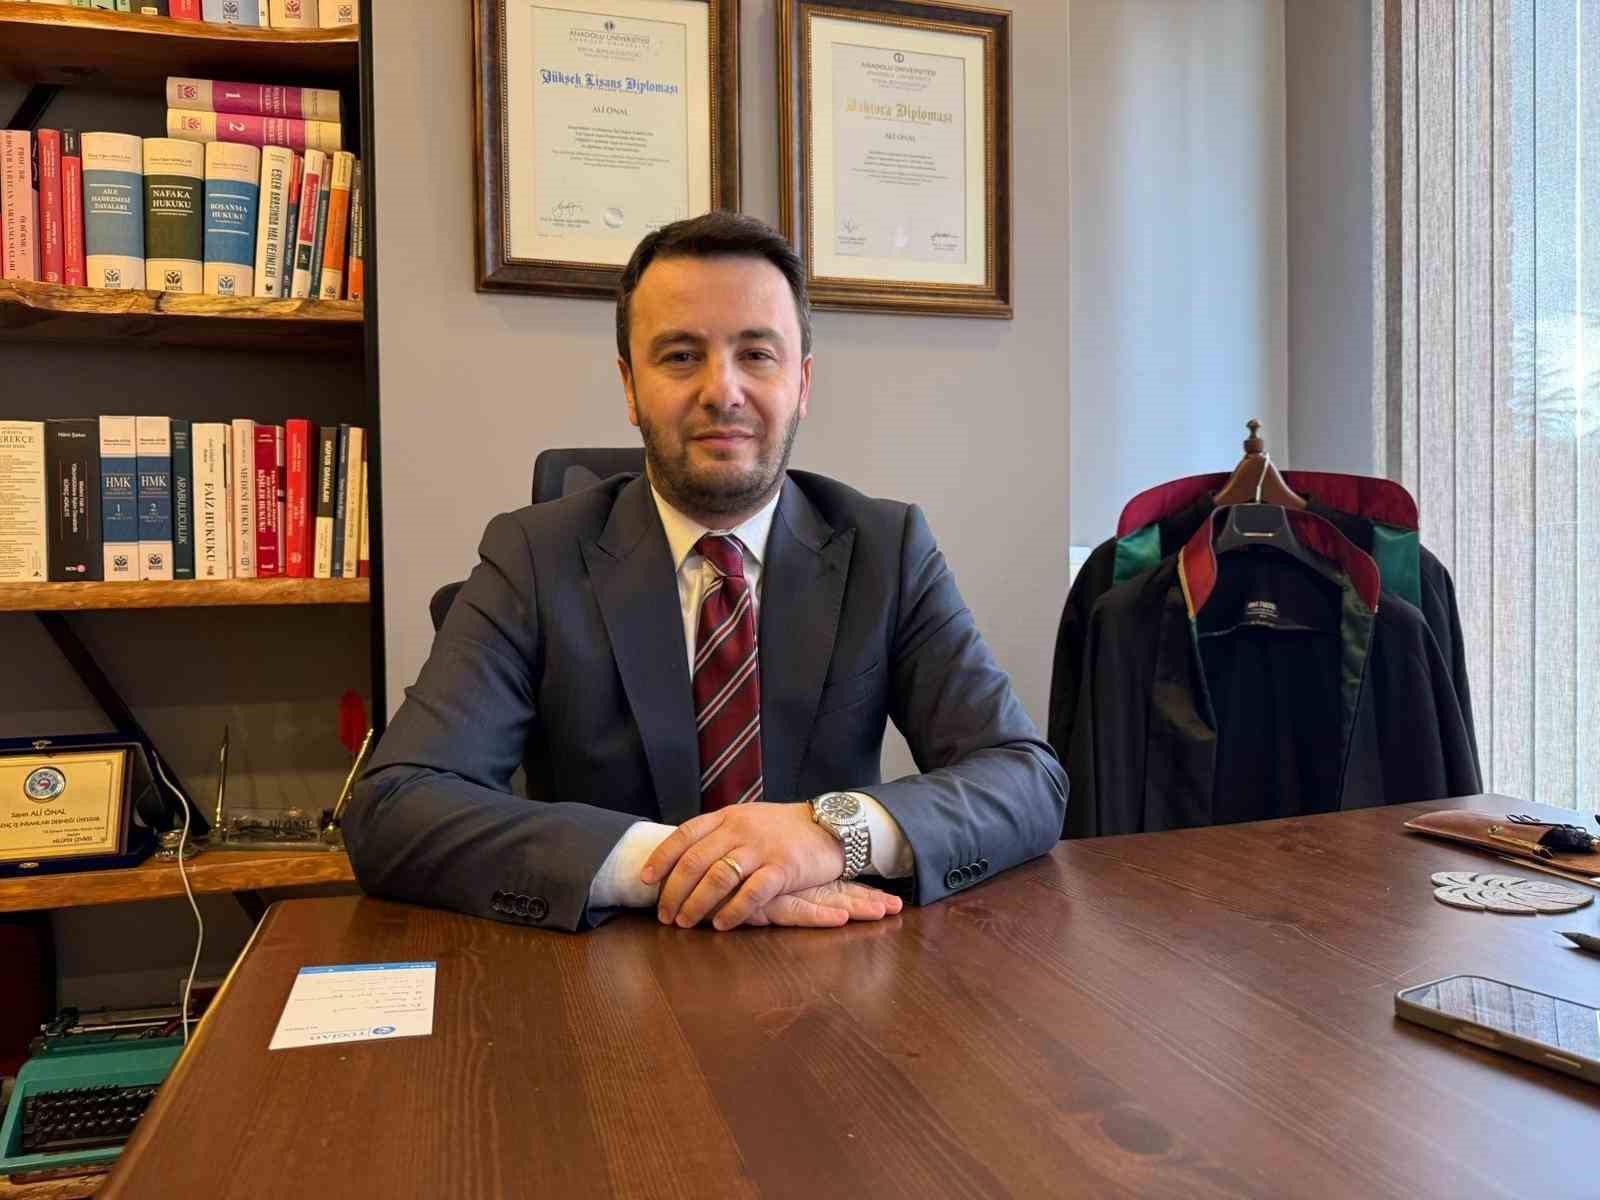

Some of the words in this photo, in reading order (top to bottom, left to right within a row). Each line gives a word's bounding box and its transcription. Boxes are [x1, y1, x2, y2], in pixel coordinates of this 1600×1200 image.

[584, 72, 623, 89] Lisans
[152, 189, 191, 199] NAFAKA
[152, 199, 192, 209] HUKUKU
[323, 440, 332, 466] NÜFUS
[105, 476, 132, 489] HMK
[141, 475, 169, 488] HMK
[322, 466, 331, 503] DAVALARI
[204, 482, 217, 510] FAİZ
[177, 475, 188, 545] ARABULUCULUK
[204, 511, 215, 562] HUKUKU
